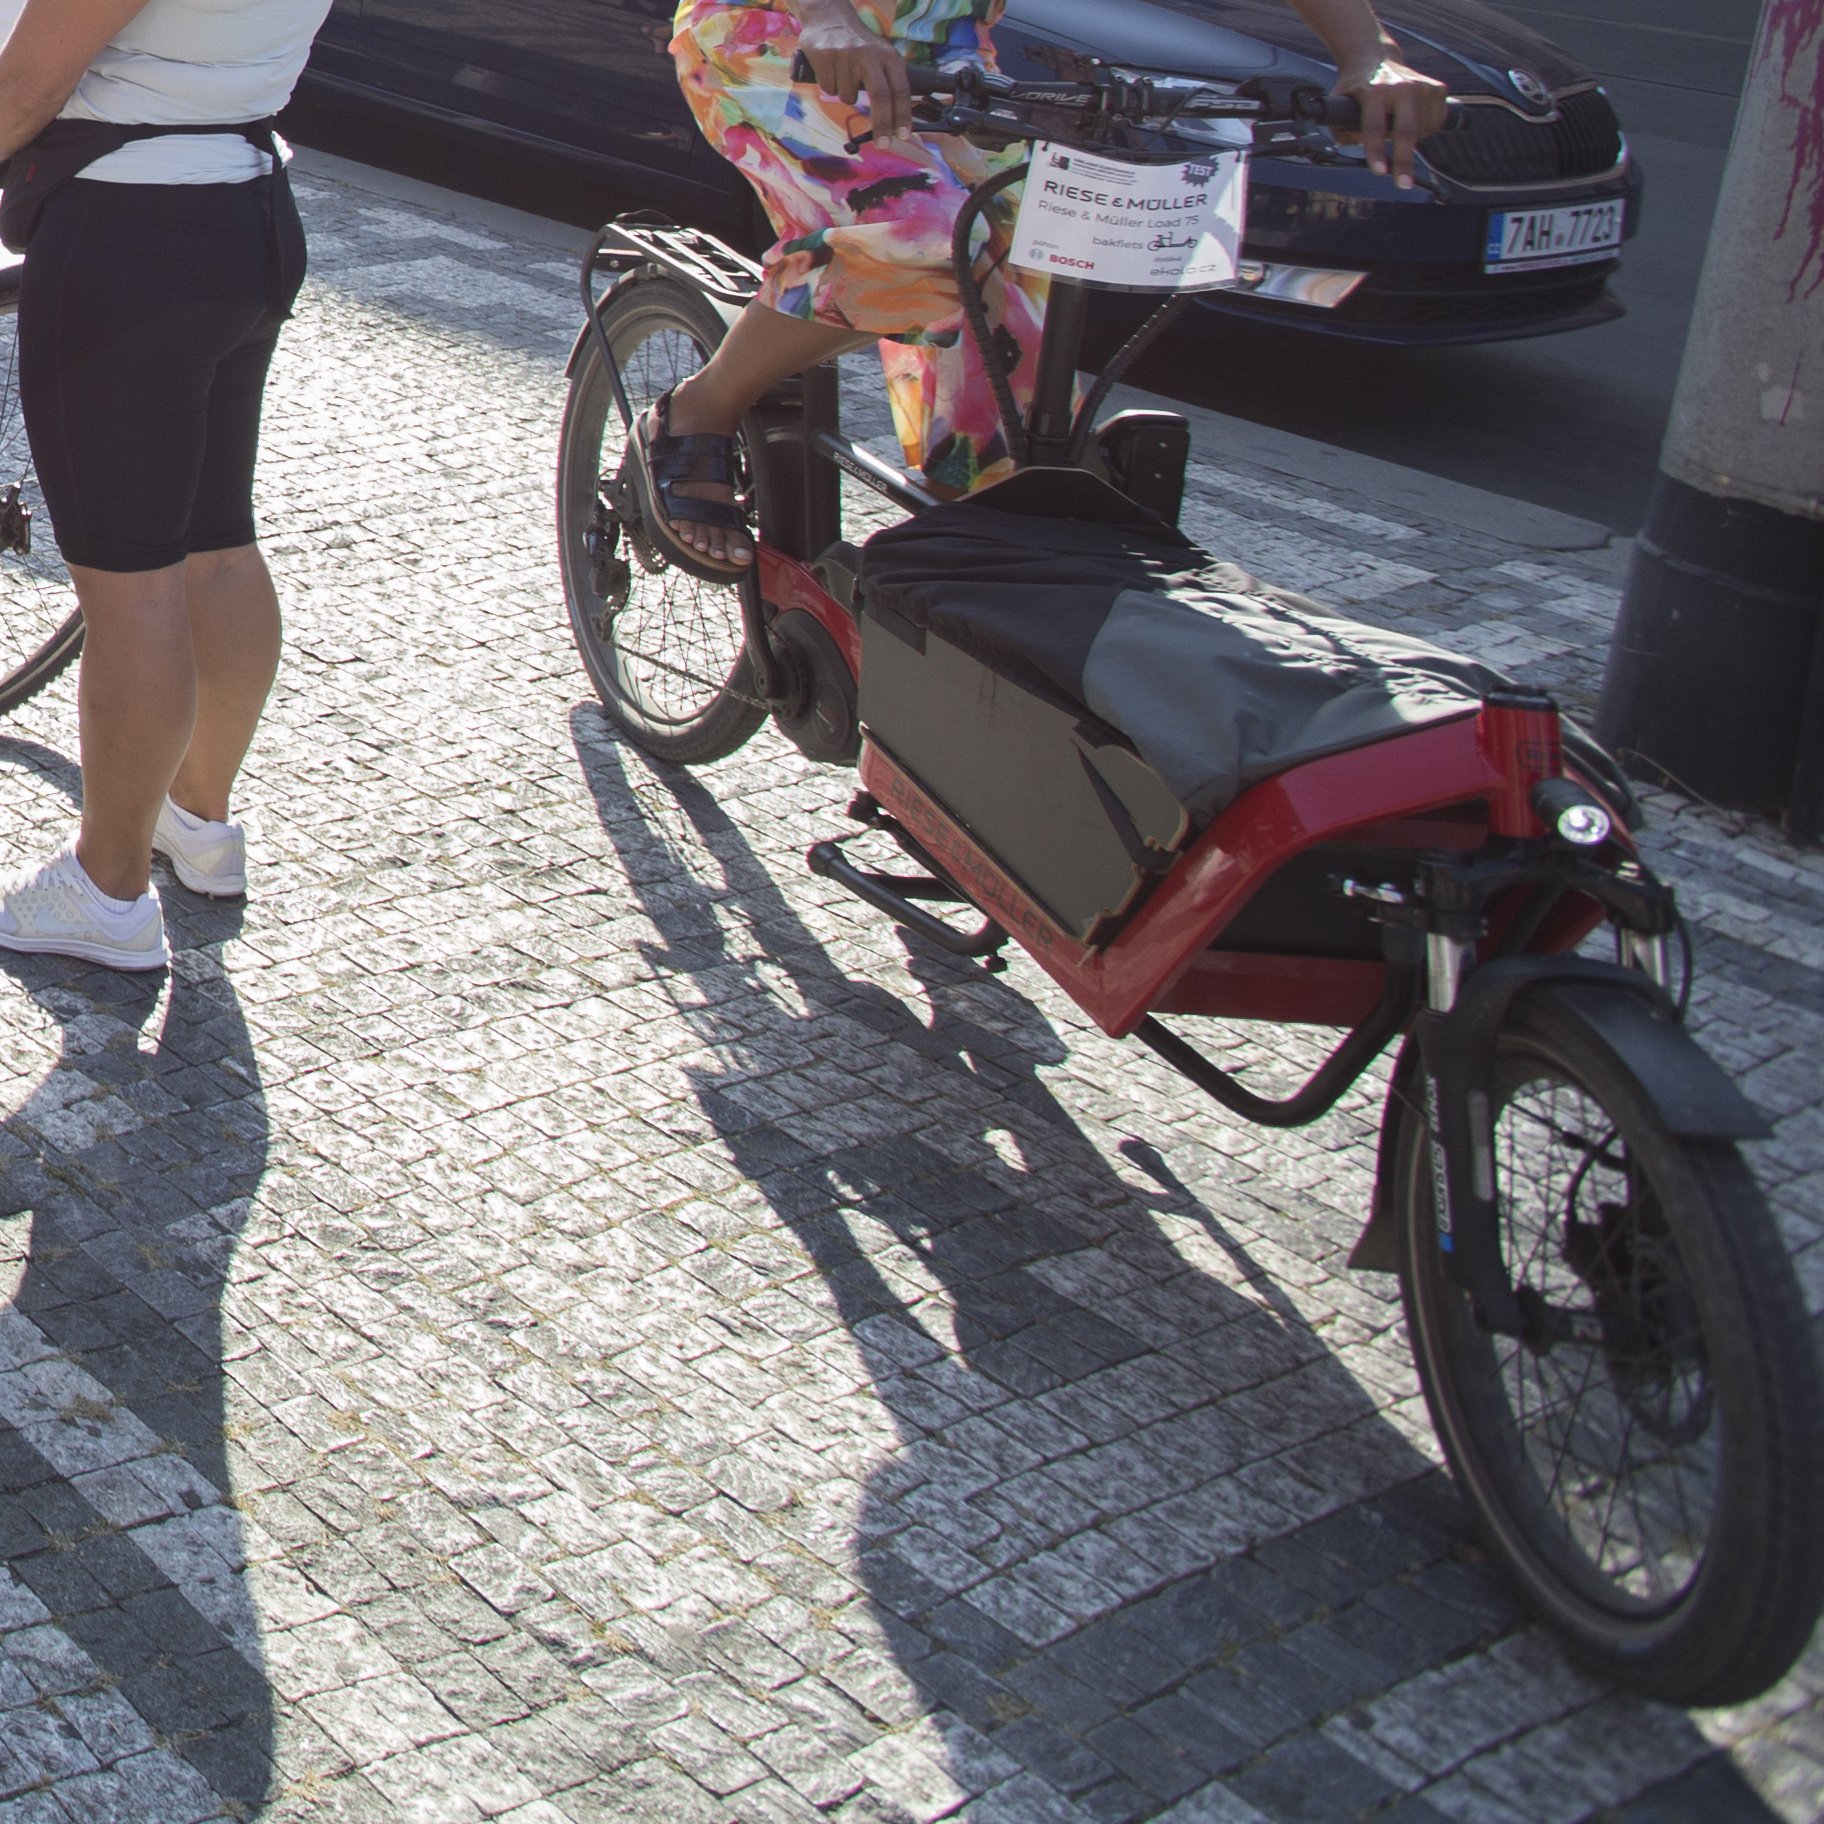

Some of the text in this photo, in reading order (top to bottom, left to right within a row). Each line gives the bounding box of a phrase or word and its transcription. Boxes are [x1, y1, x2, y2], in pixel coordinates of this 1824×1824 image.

[1188, 164, 1213, 176] TEST
[1043, 180, 1108, 206] RIESE
[1126, 193, 1208, 211] MÜLLER
[1038, 200, 1200, 229] Riese & Müller Load 75
[1505, 213, 1555, 254] 7AH
[1566, 205, 1616, 248] 7723
[1092, 236, 1144, 251] bakfiets
[1049, 254, 1095, 271] BOSCH
